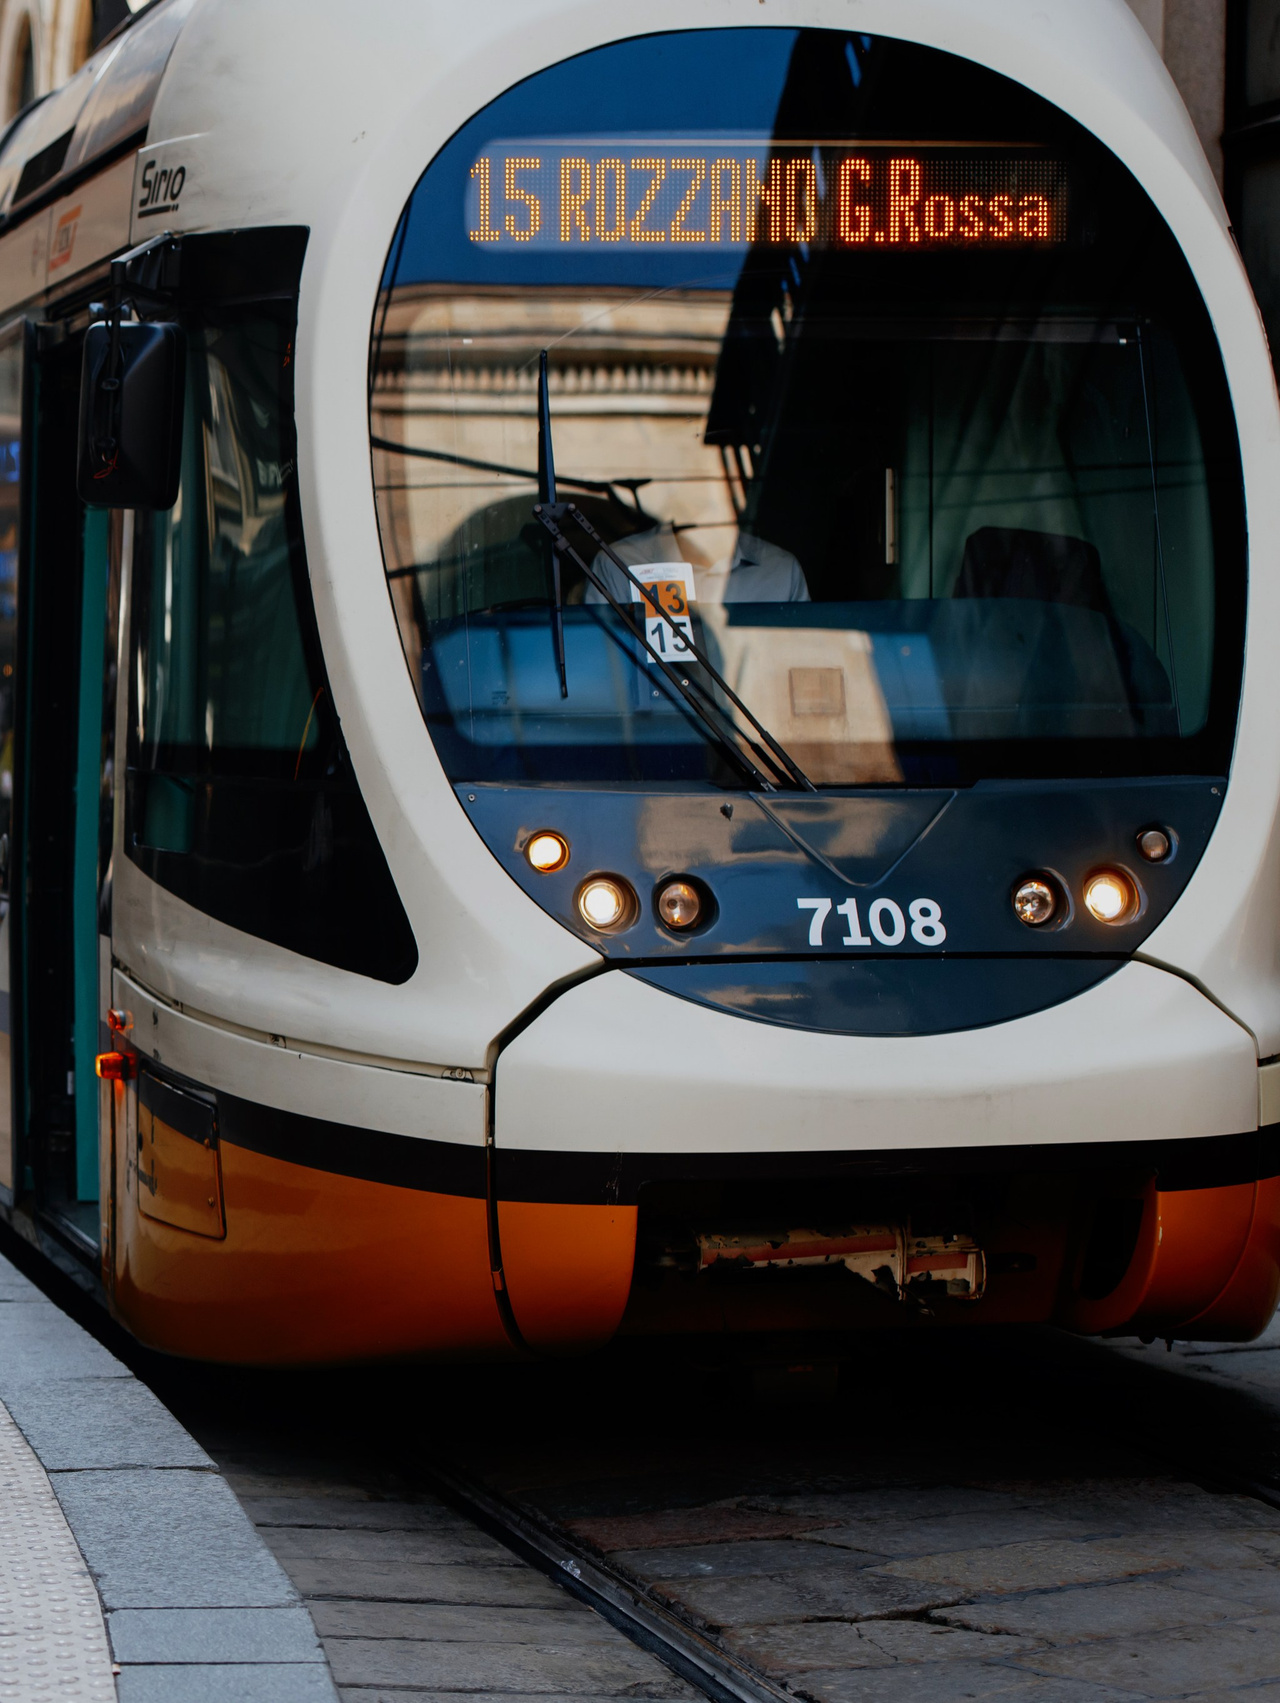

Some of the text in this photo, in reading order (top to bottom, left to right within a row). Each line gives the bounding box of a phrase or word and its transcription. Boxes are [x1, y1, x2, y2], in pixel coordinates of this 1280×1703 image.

[139, 159, 186, 208] Sirio
[468, 157, 1049, 242] 15 ROZZANO G.Rossa
[648, 583, 685, 614] 13
[651, 621, 690, 653] 15
[796, 897, 948, 947] 7108
